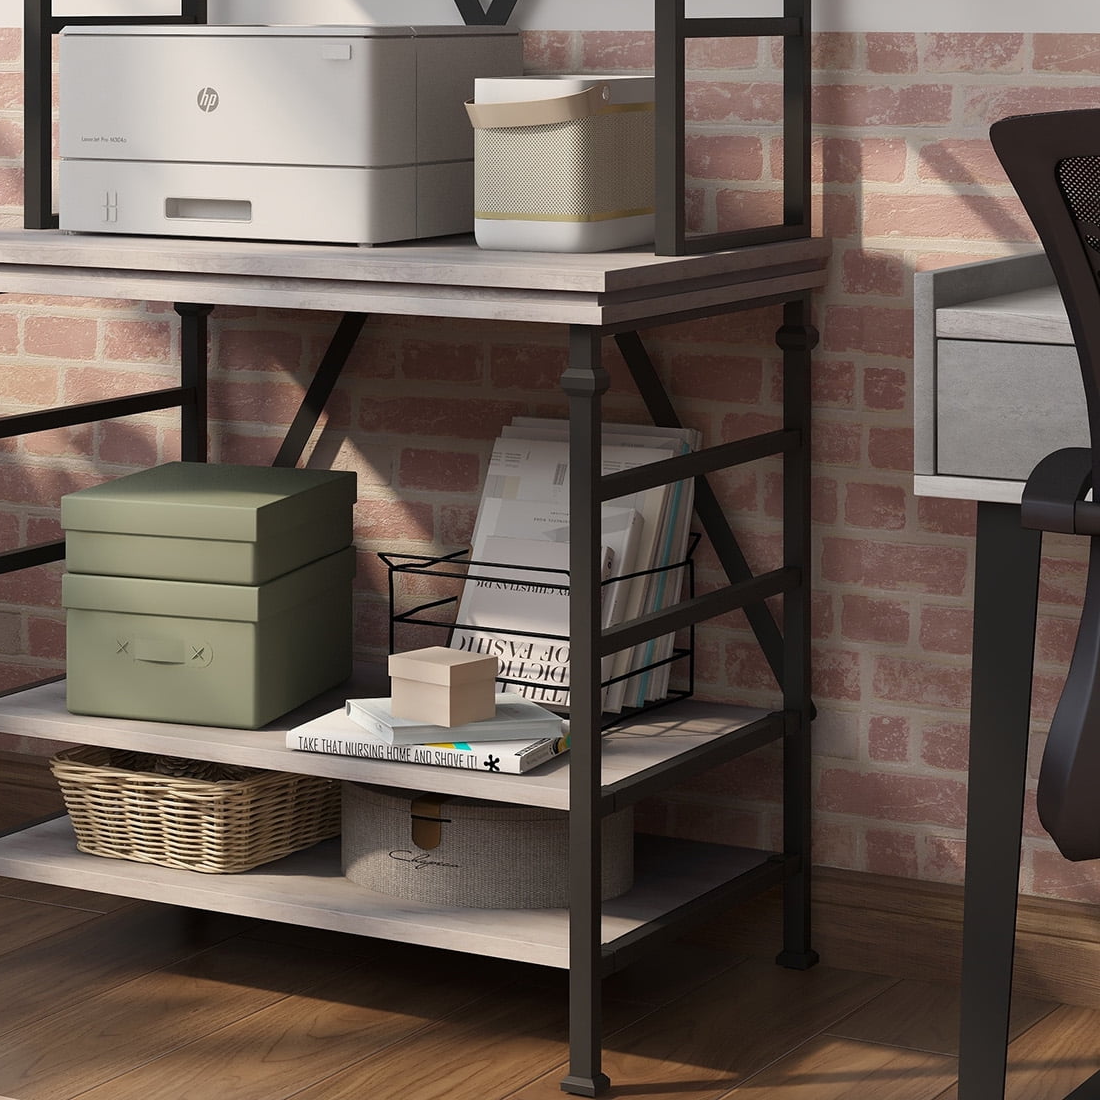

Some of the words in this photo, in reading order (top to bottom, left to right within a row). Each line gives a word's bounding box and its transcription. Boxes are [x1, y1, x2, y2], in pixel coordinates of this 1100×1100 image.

[198, 86, 219, 113] hp
[495, 582, 555, 596] CHRISTIAN
[540, 645, 570, 664] OF
[298, 736, 319, 751] TAKE
[321, 738, 343, 753] THAT
[345, 742, 384, 759] NURSING
[386, 746, 411, 762] HOME
[414, 750, 432, 765] AND
[434, 751, 464, 768] SHOVE
[466, 754, 478, 769] IT!
